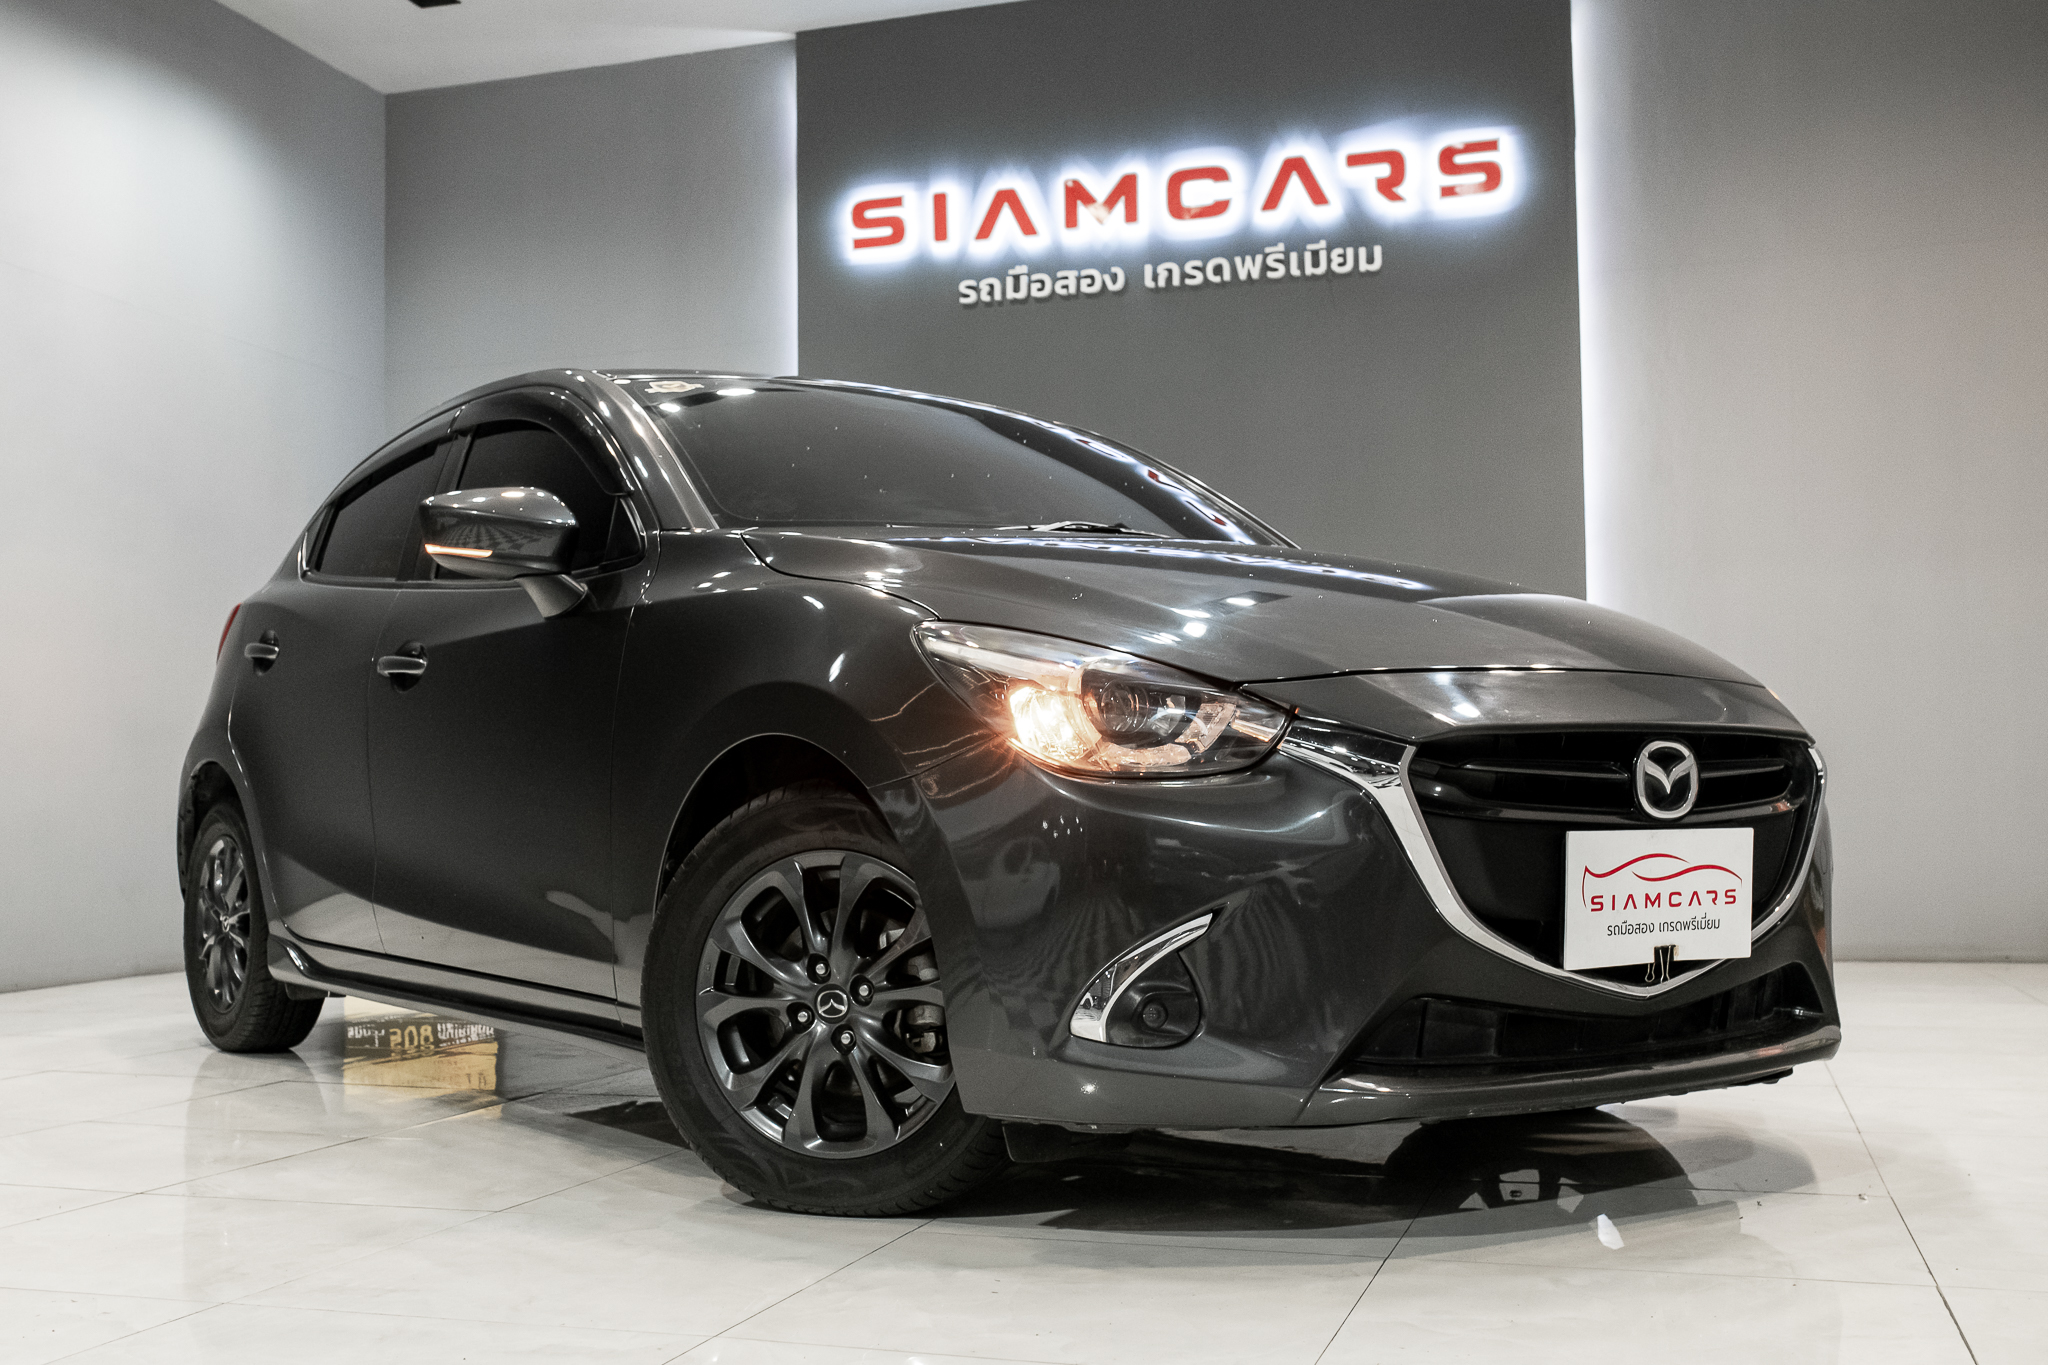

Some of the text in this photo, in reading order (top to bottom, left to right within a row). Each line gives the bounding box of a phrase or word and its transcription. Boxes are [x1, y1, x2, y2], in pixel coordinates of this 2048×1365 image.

[852, 140, 1502, 250] SIAMCARS
[958, 240, 1384, 306] รถมือสอง เกรดพรีเมียม
[1590, 888, 1737, 913] SIAMCARS
[1607, 911, 1721, 936] รถมือสอง เกรดพรีเมี่ยม
